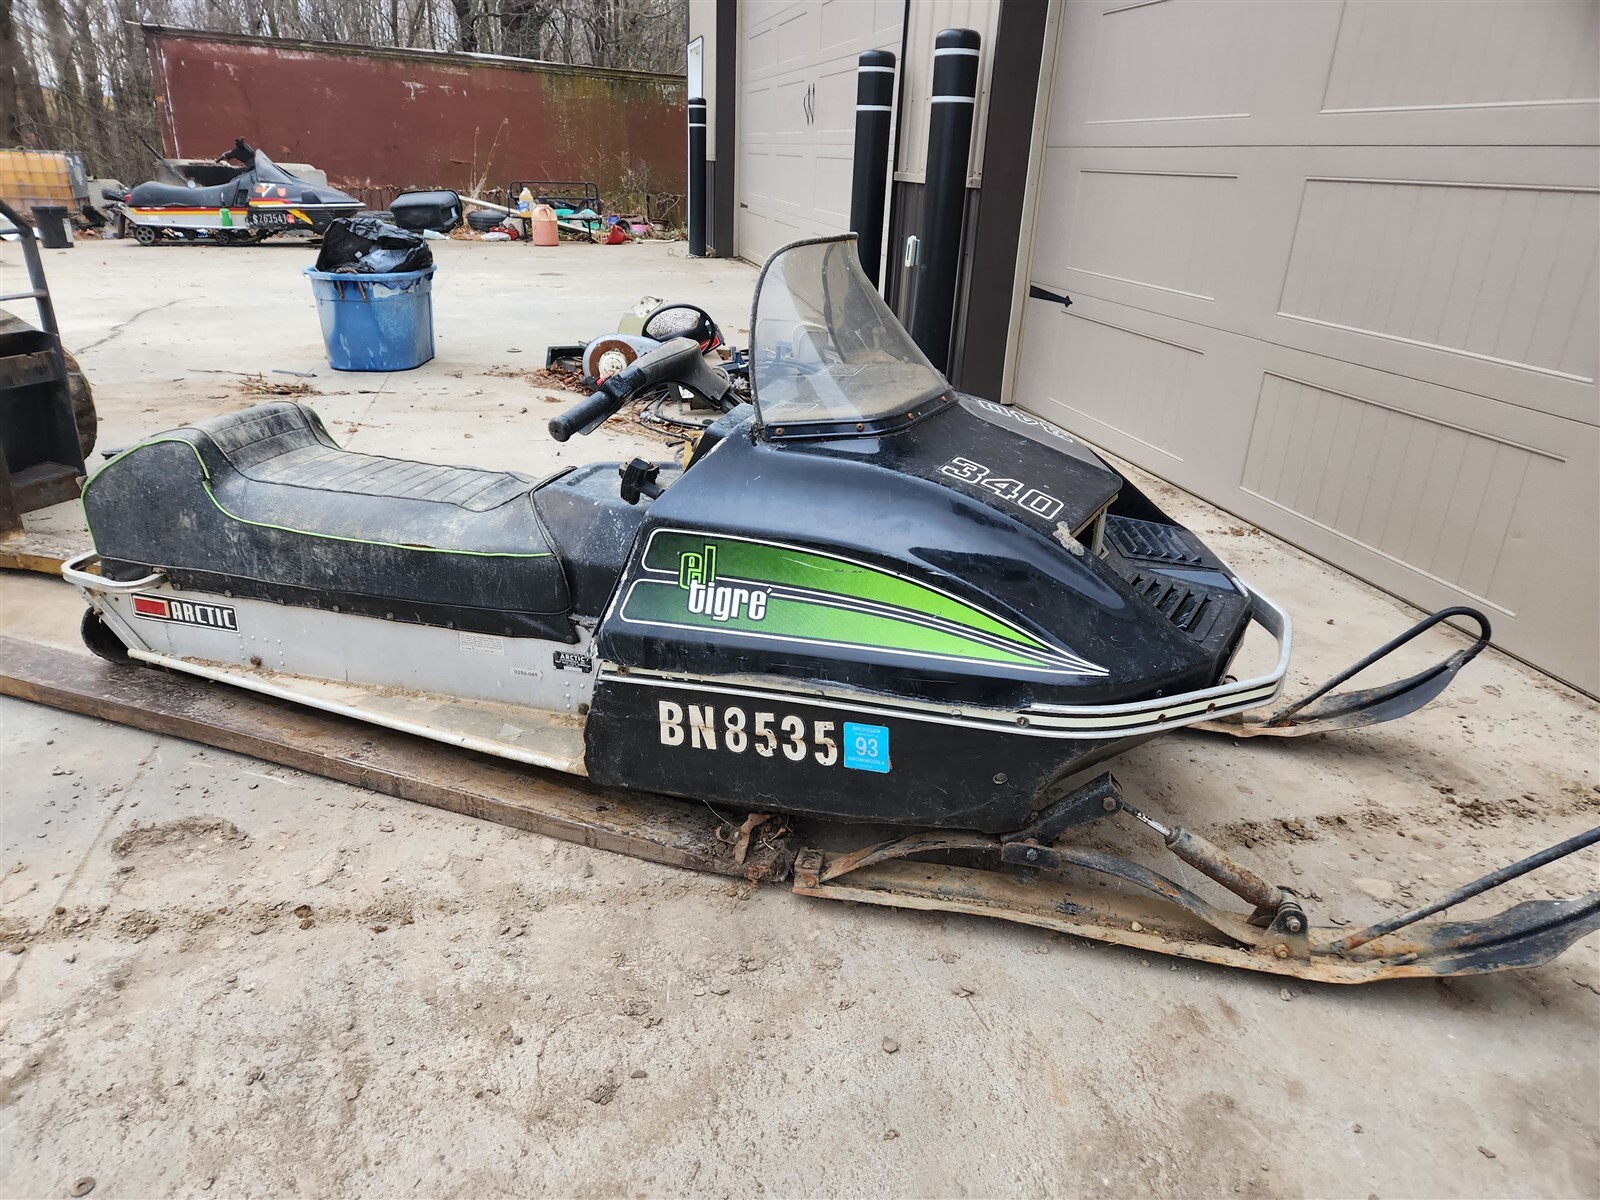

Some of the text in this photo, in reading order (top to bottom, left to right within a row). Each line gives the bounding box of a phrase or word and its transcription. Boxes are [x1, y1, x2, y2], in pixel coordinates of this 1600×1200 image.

[941, 457, 1064, 519] 340
[679, 545, 718, 590] el
[170, 601, 236, 629] ARCTIC
[658, 700, 838, 767] BN8535
[855, 736, 879, 758] 93
